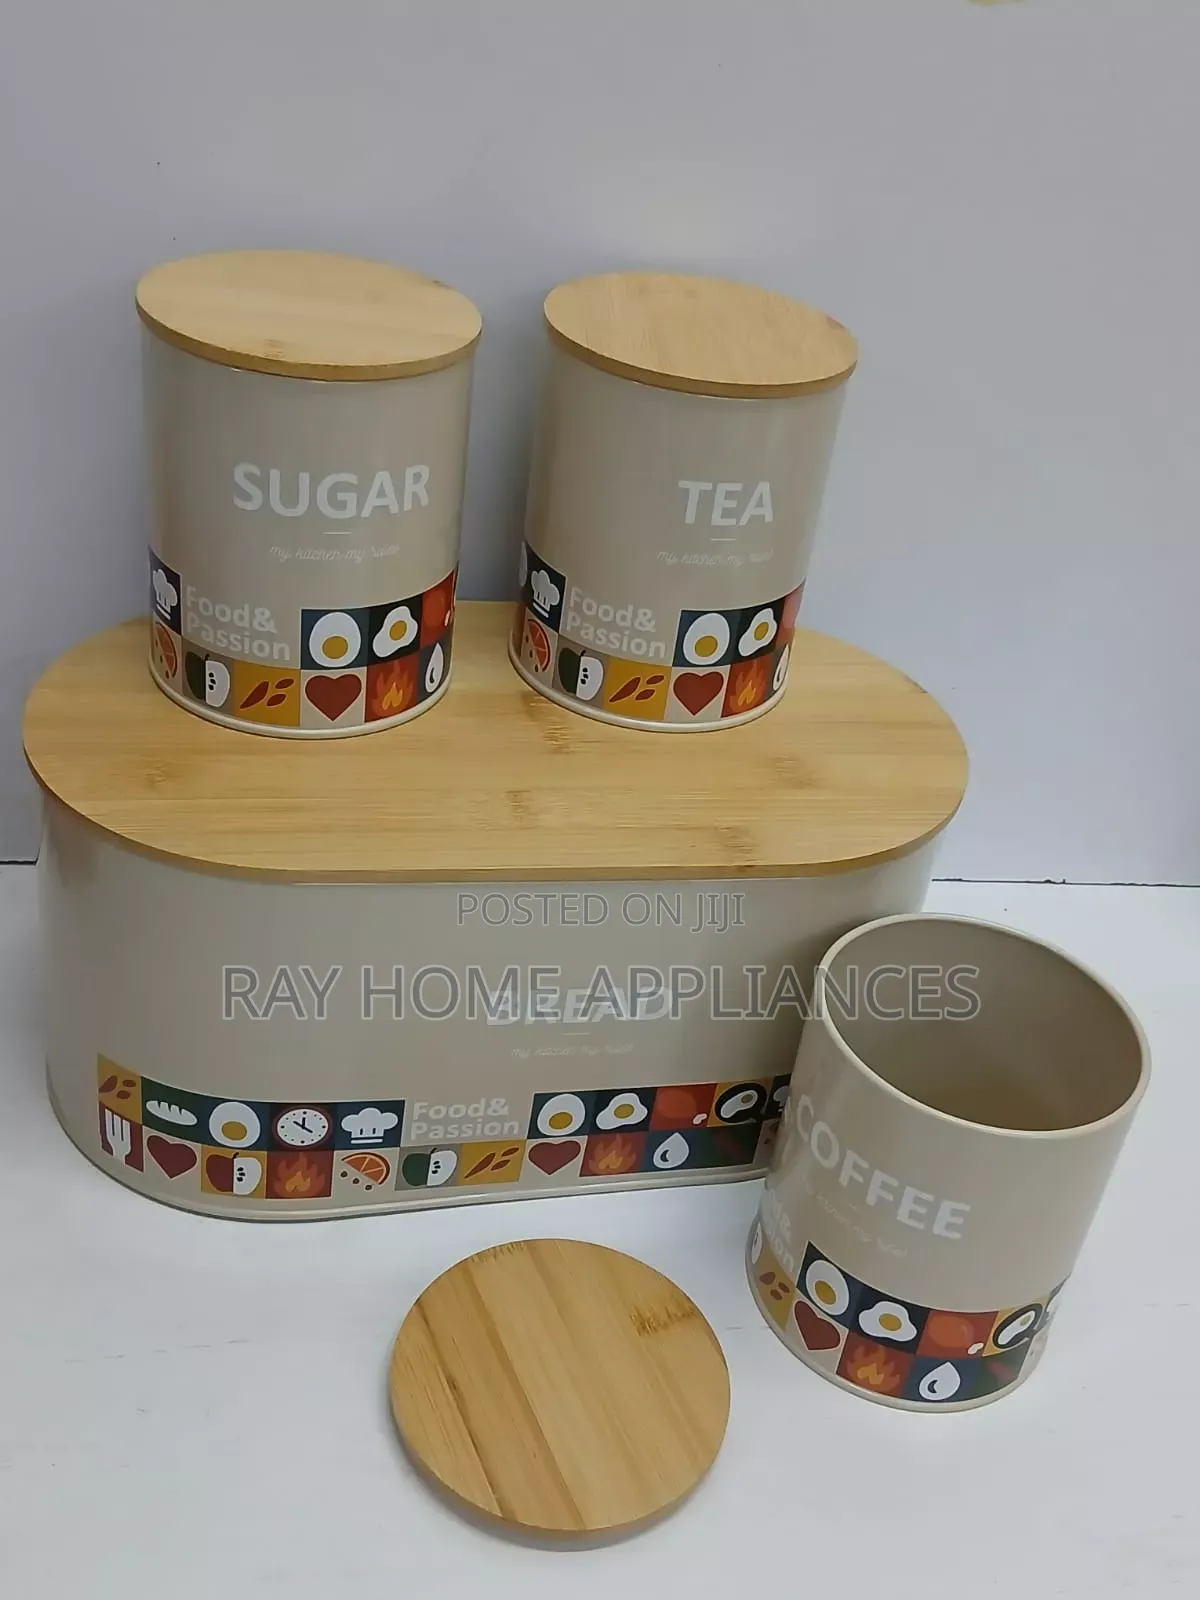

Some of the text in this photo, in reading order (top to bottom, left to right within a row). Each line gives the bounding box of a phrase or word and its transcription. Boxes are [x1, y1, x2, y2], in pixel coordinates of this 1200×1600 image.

[233, 462, 430, 519] SUGAR
[678, 480, 774, 526] TEA
[186, 585, 277, 634] Food&
[569, 587, 656, 633] Food&
[186, 611, 291, 661] Passion
[567, 611, 666, 659] Passion
[410, 1119, 519, 1141] Passion
[412, 1098, 509, 1121] Food&
[796, 1094, 971, 1239] COFFEE
